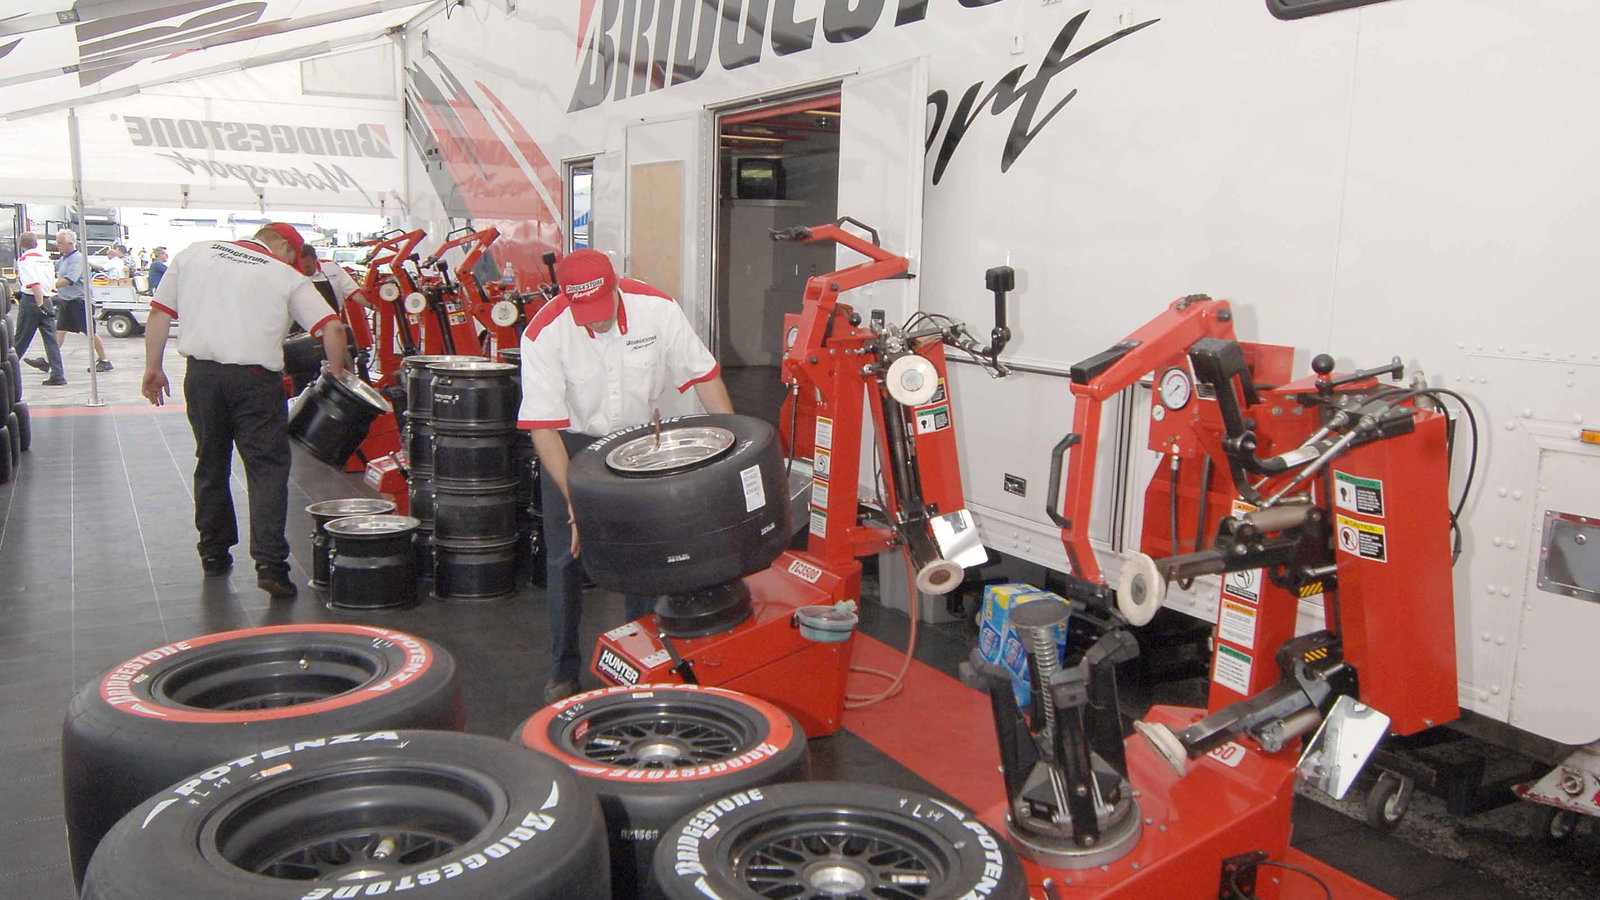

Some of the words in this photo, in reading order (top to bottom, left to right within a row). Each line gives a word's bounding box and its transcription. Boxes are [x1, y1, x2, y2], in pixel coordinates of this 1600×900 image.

[105, 640, 192, 705] BRIDGESTONE
[368, 634, 426, 691] POTENZA
[601, 649, 639, 684] HUNTER
[552, 684, 698, 709] POTENZA
[174, 731, 399, 796] POTENZA
[608, 742, 779, 779] BRIDGESTONE
[301, 811, 556, 900] BRIDGESTONE
[675, 788, 764, 876] BRIDGESTONE
